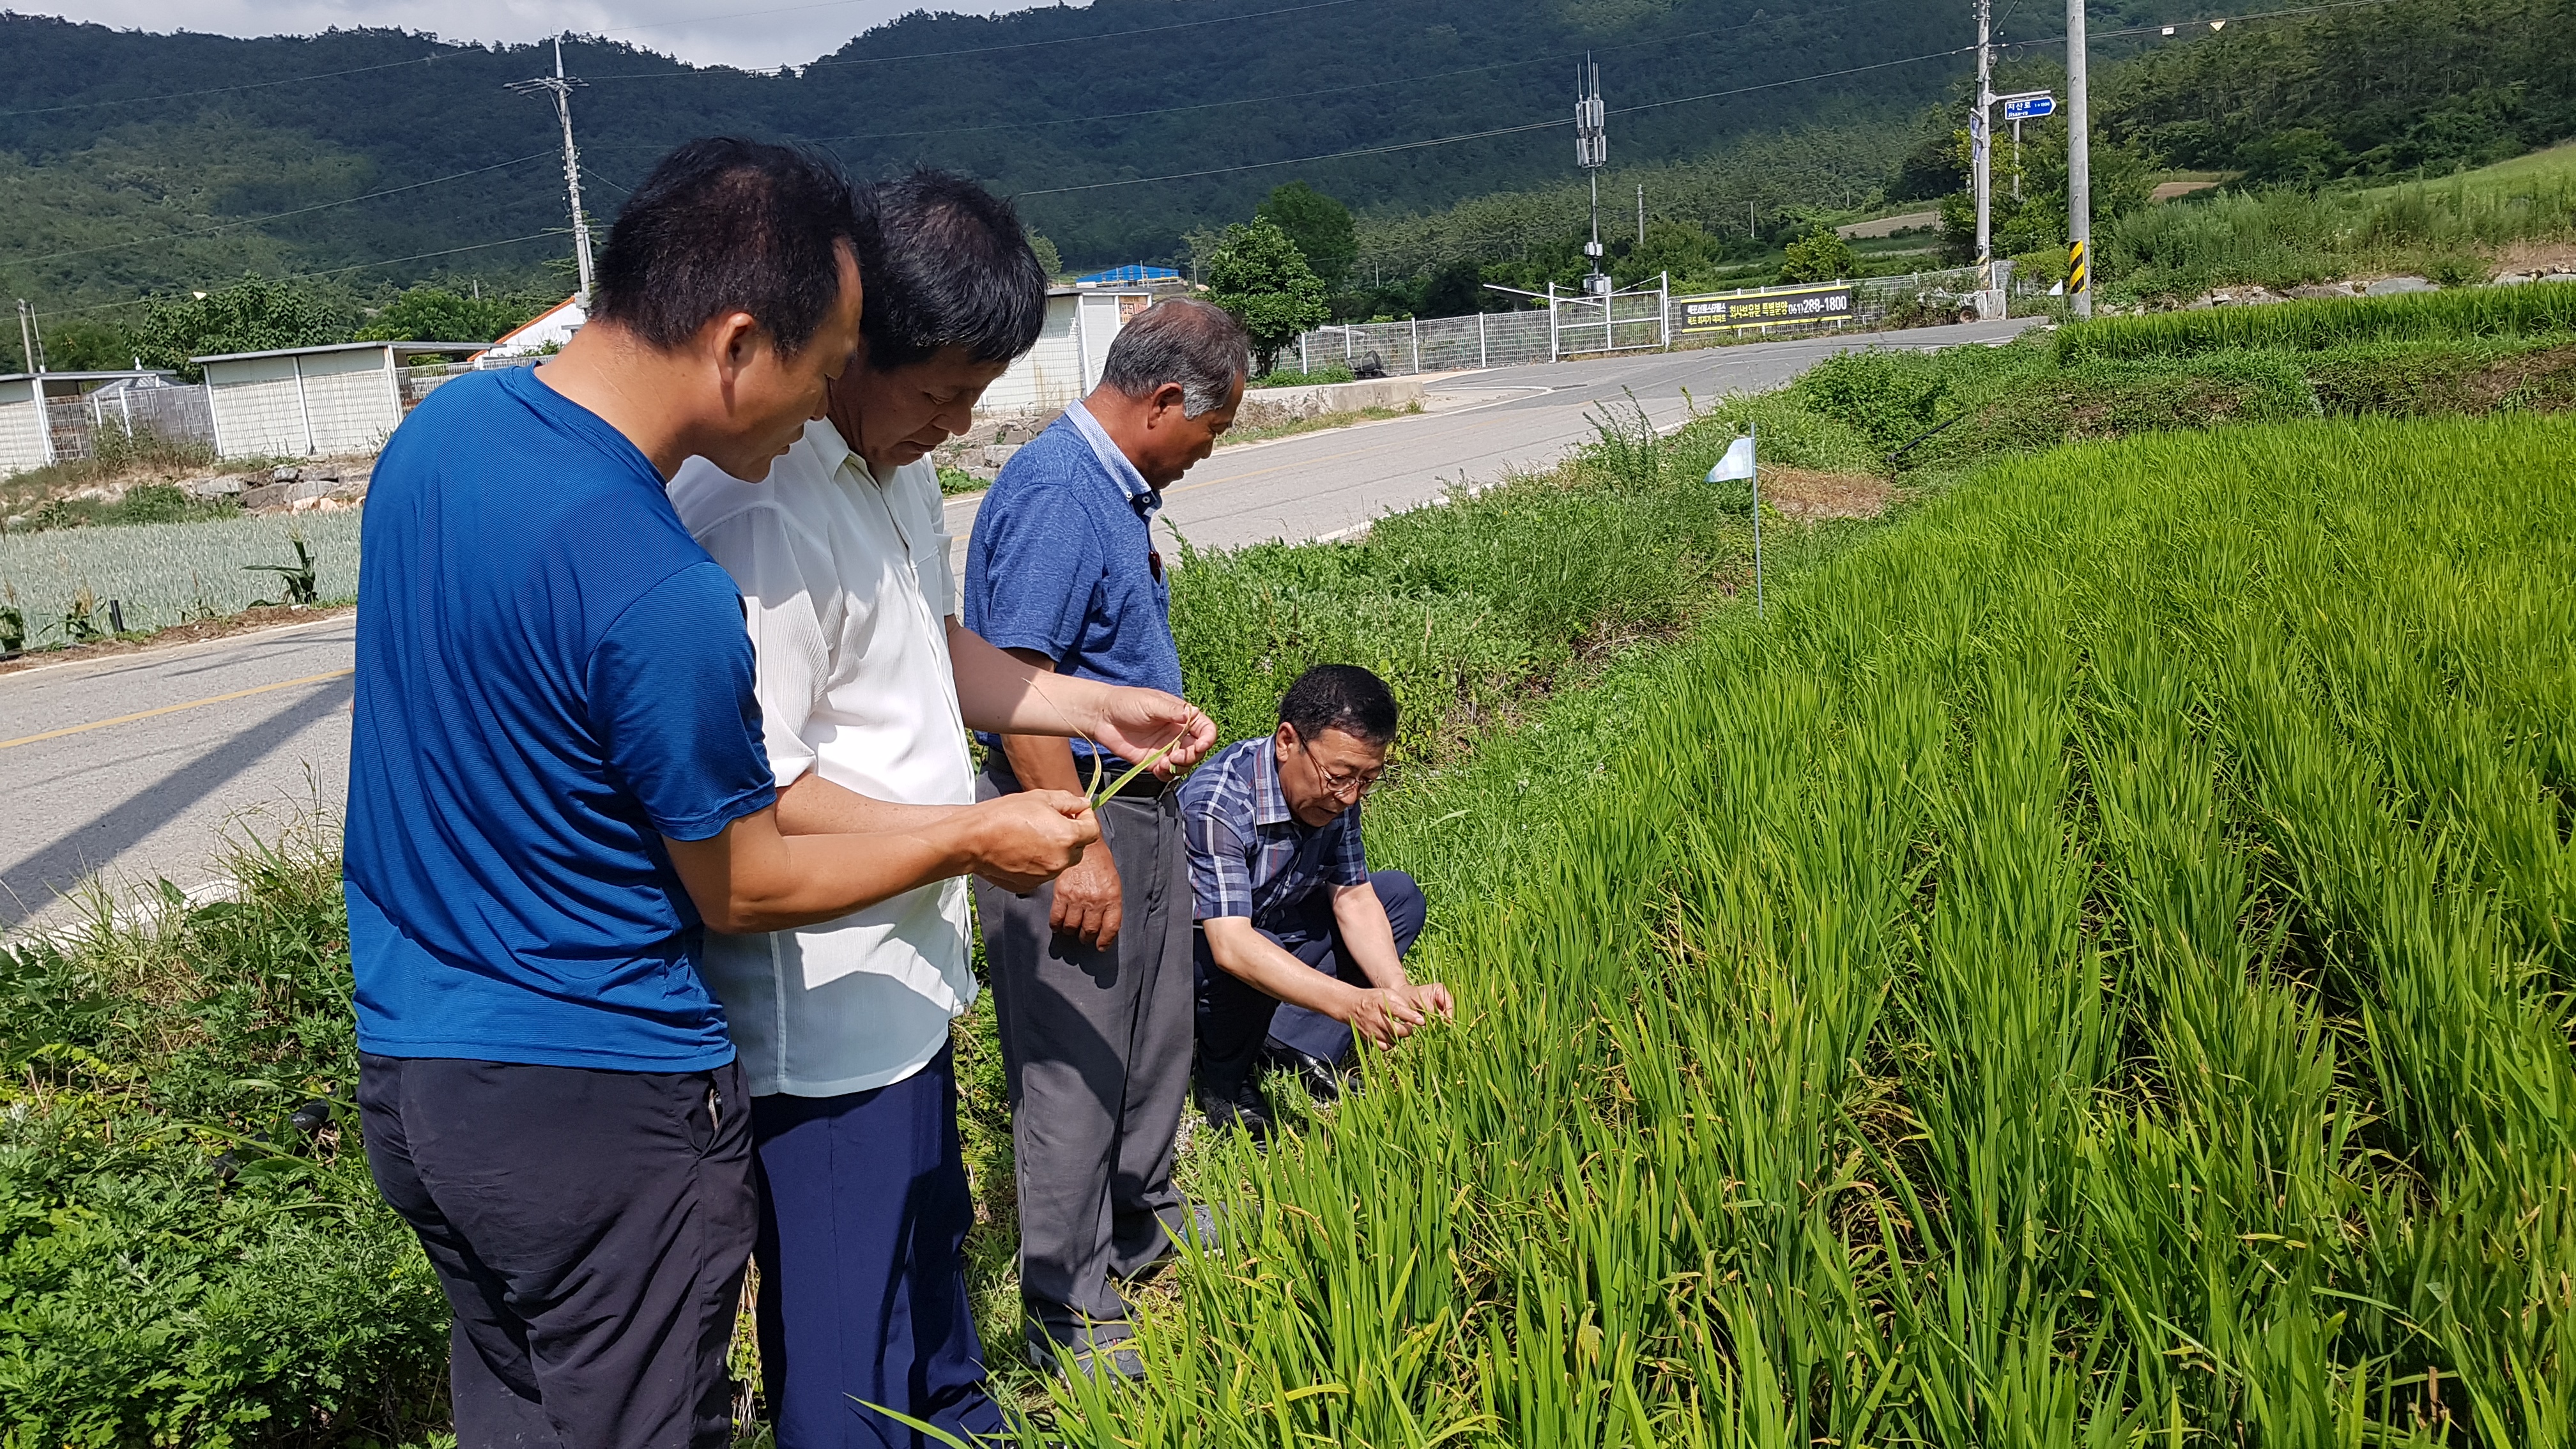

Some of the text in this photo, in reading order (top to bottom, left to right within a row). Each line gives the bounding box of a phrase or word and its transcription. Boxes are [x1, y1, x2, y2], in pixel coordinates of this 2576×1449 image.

[2008, 102, 2031, 111] 지산로
[1729, 303, 1761, 319] 회사보유분
[1762, 300, 1788, 316] 특별분양
